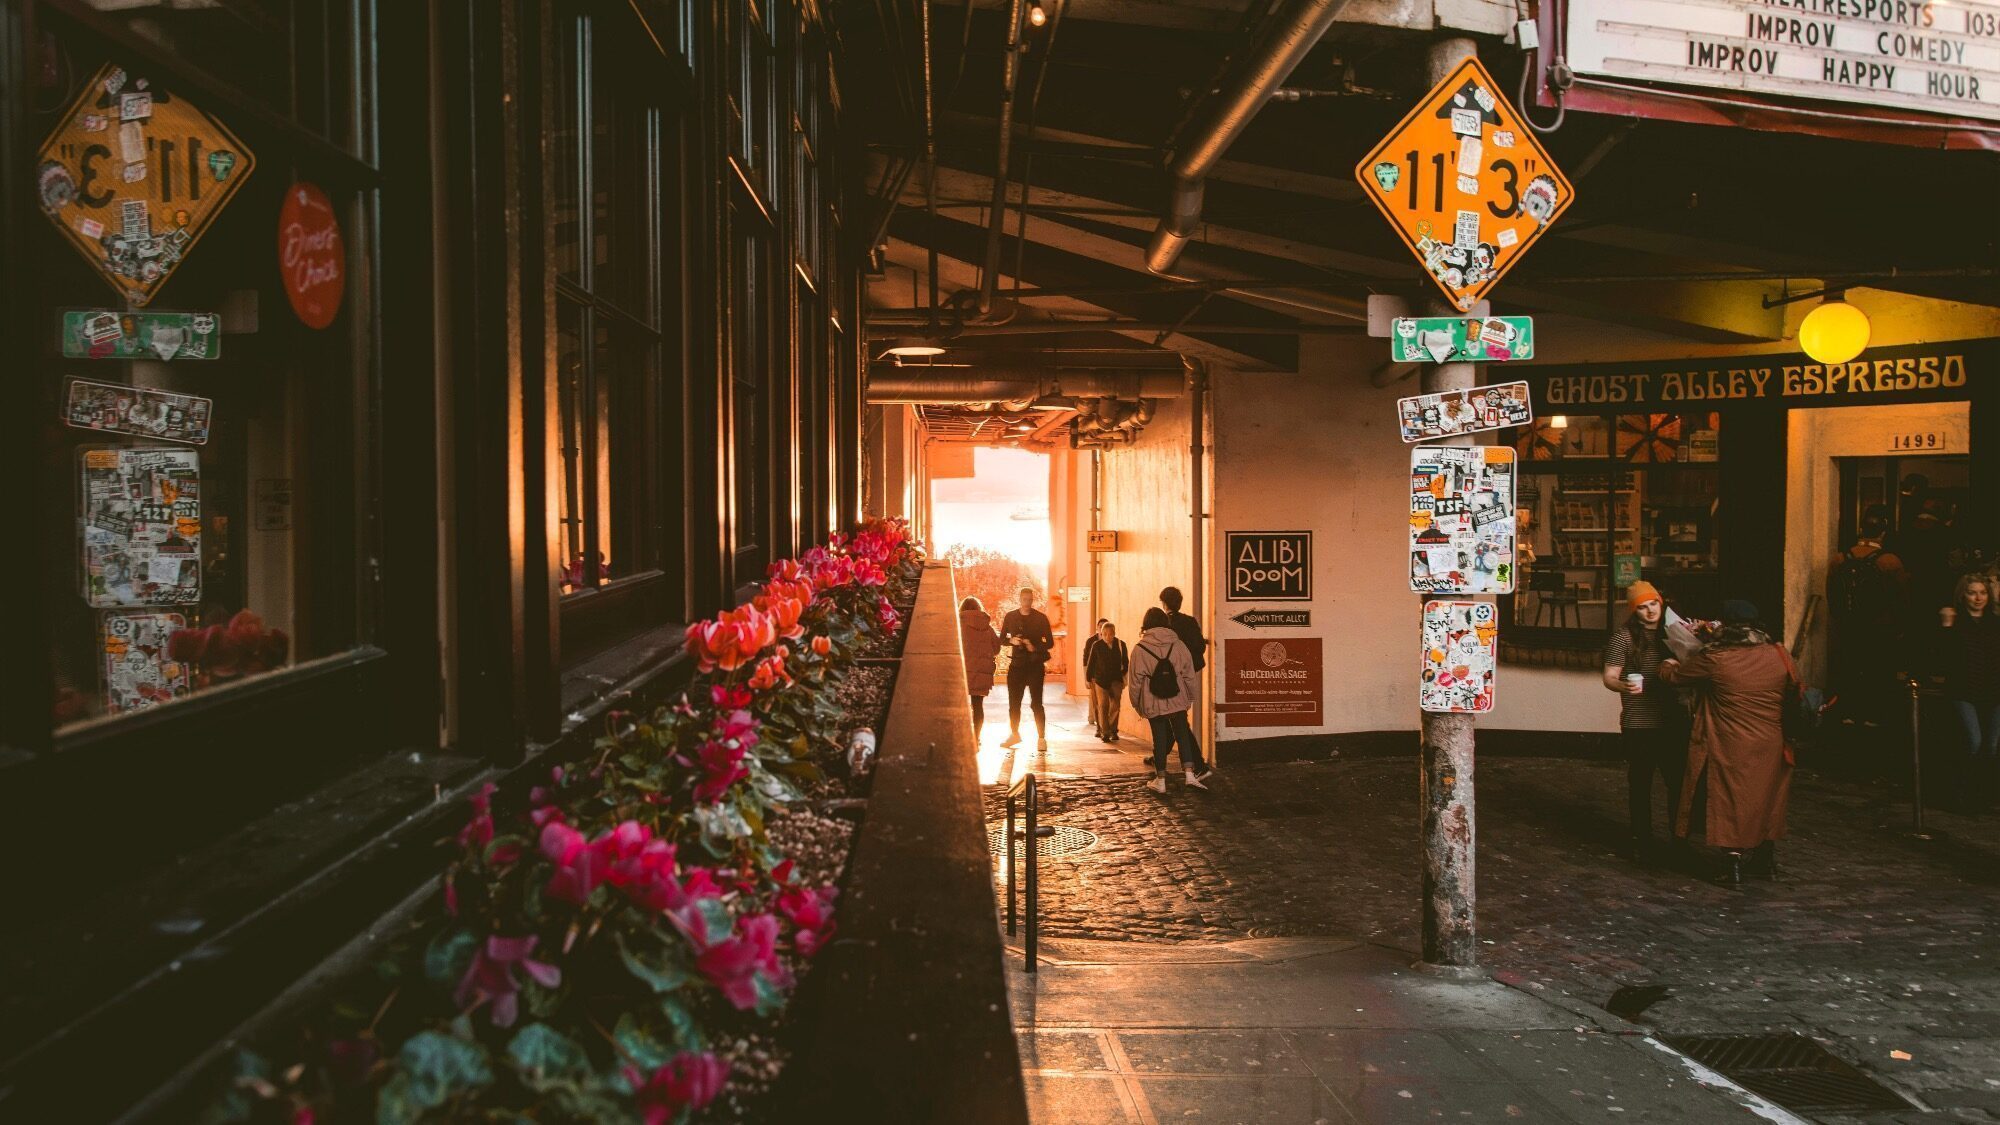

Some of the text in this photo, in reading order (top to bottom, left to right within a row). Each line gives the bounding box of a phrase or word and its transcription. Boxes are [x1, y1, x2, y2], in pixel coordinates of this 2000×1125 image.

[1965, 11, 2000, 37] 103
[1748, 14, 1965, 65] IMPROV COMEDY
[1688, 40, 1980, 100] IMPROV HAPPY HOUR
[1405, 149, 1536, 219] 11' 3"
[1546, 355, 1967, 404] GHOST ALLEY ESPRESSO
[1893, 433, 1937, 449] 1499
[1239, 540, 1301, 563] ALIBI
[1235, 566, 1302, 592] ROOM
[1243, 614, 1306, 623] DOWN THE ALLEY
